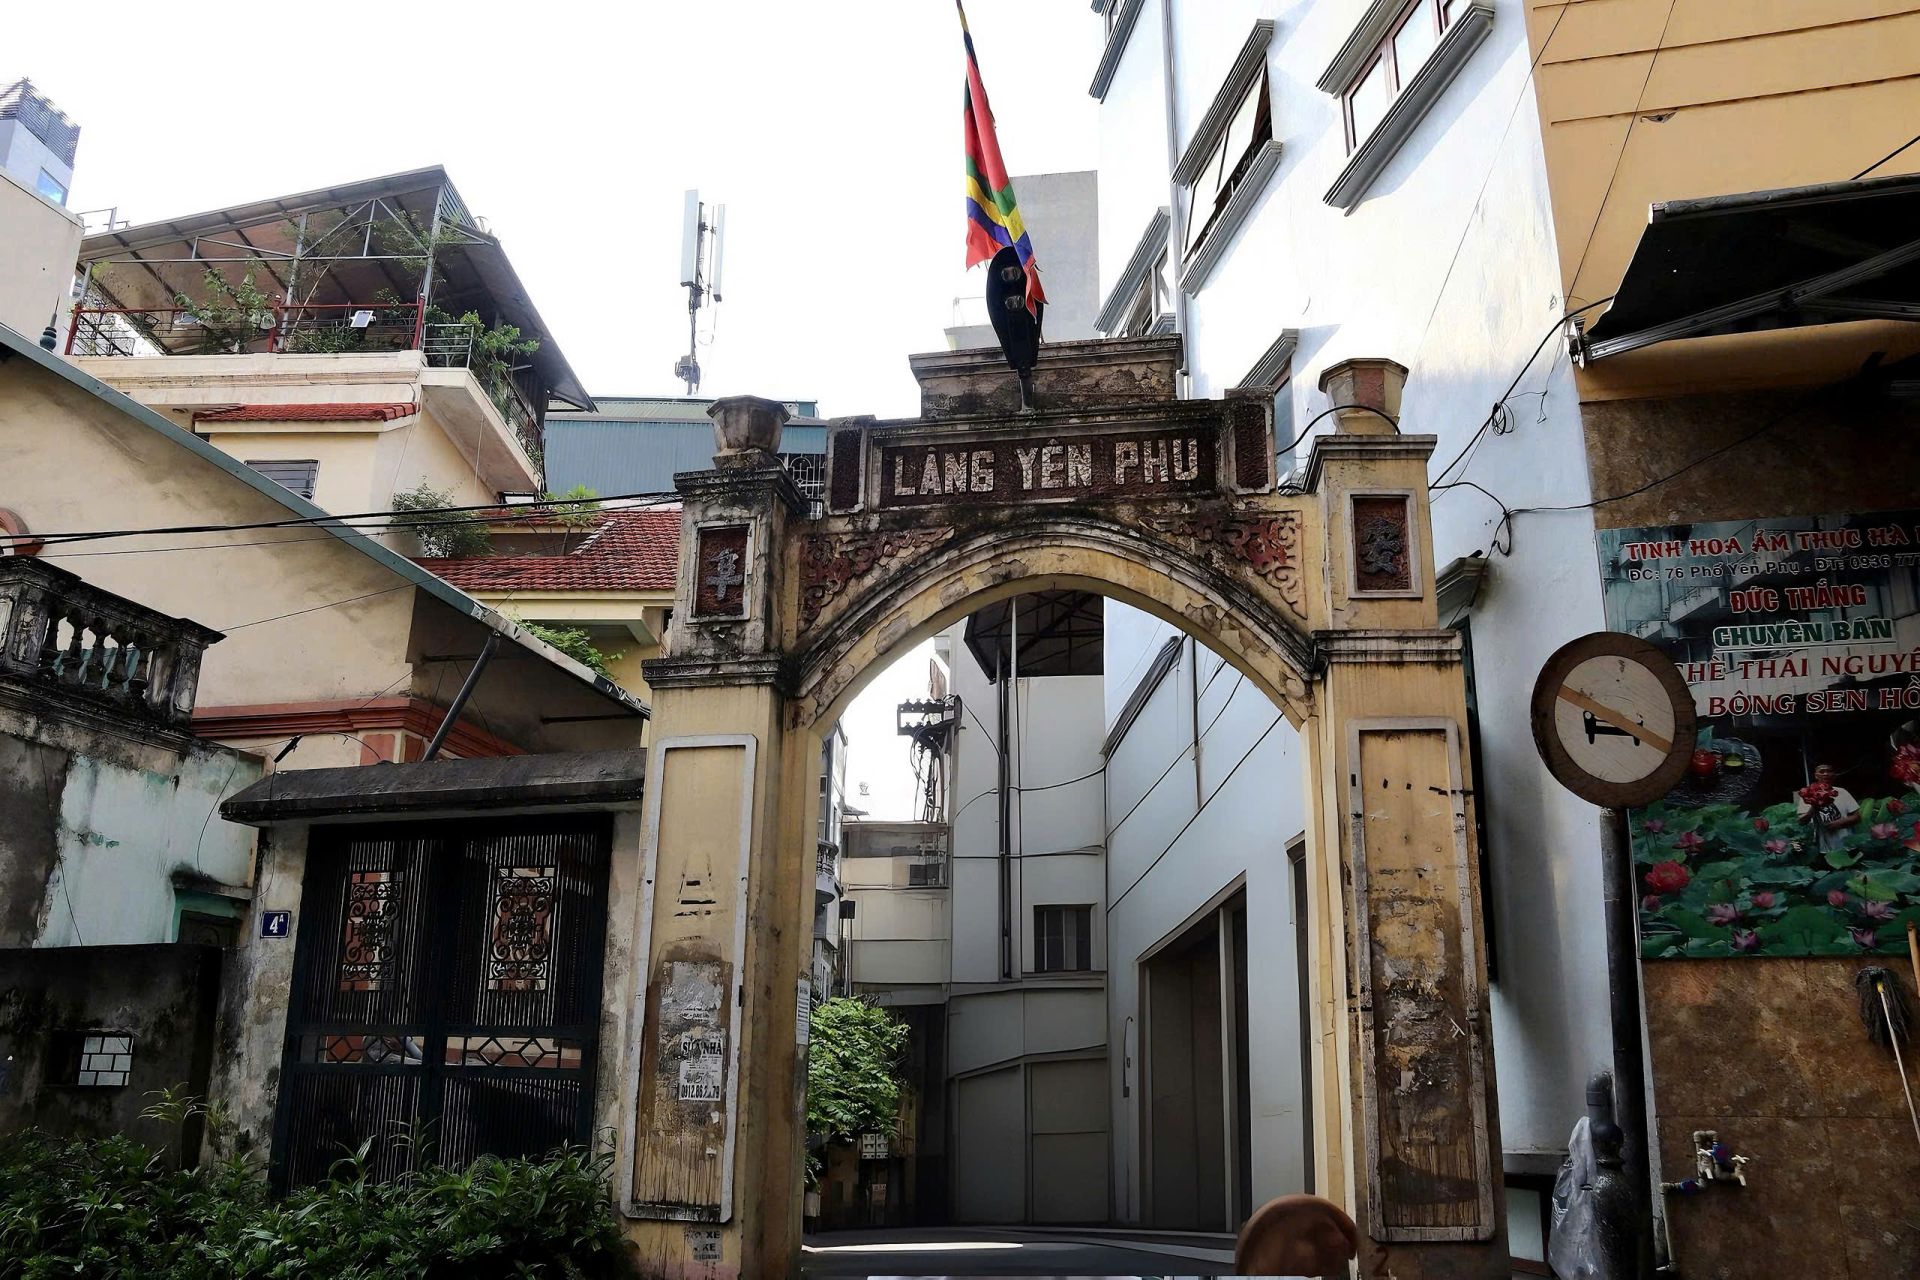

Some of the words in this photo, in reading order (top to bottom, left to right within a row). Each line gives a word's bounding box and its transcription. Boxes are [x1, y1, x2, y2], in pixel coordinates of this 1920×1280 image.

[1016, 438, 1092, 490] YÊN
[1625, 539, 1682, 561] TINH
[1690, 536, 1744, 557] HOA
[1797, 528, 1862, 554] THỰC
[1867, 523, 1910, 548] HÀ
[1629, 567, 1660, 582] ĐC:
[1665, 566, 1684, 580] 76
[1690, 561, 1724, 578] Phố
[1727, 561, 1760, 578] Yên
[1765, 559, 1800, 576] Phụ
[1848, 553, 1892, 570] 0936
[1729, 585, 1780, 613] ĐỨC
[1712, 619, 1825, 648] CHUYÊN
[1742, 651, 1809, 679] THÁI
[1707, 689, 1797, 718] BÔNG
[1806, 690, 1868, 714] SEN
[703, 1038, 722, 1055] NHÀ
